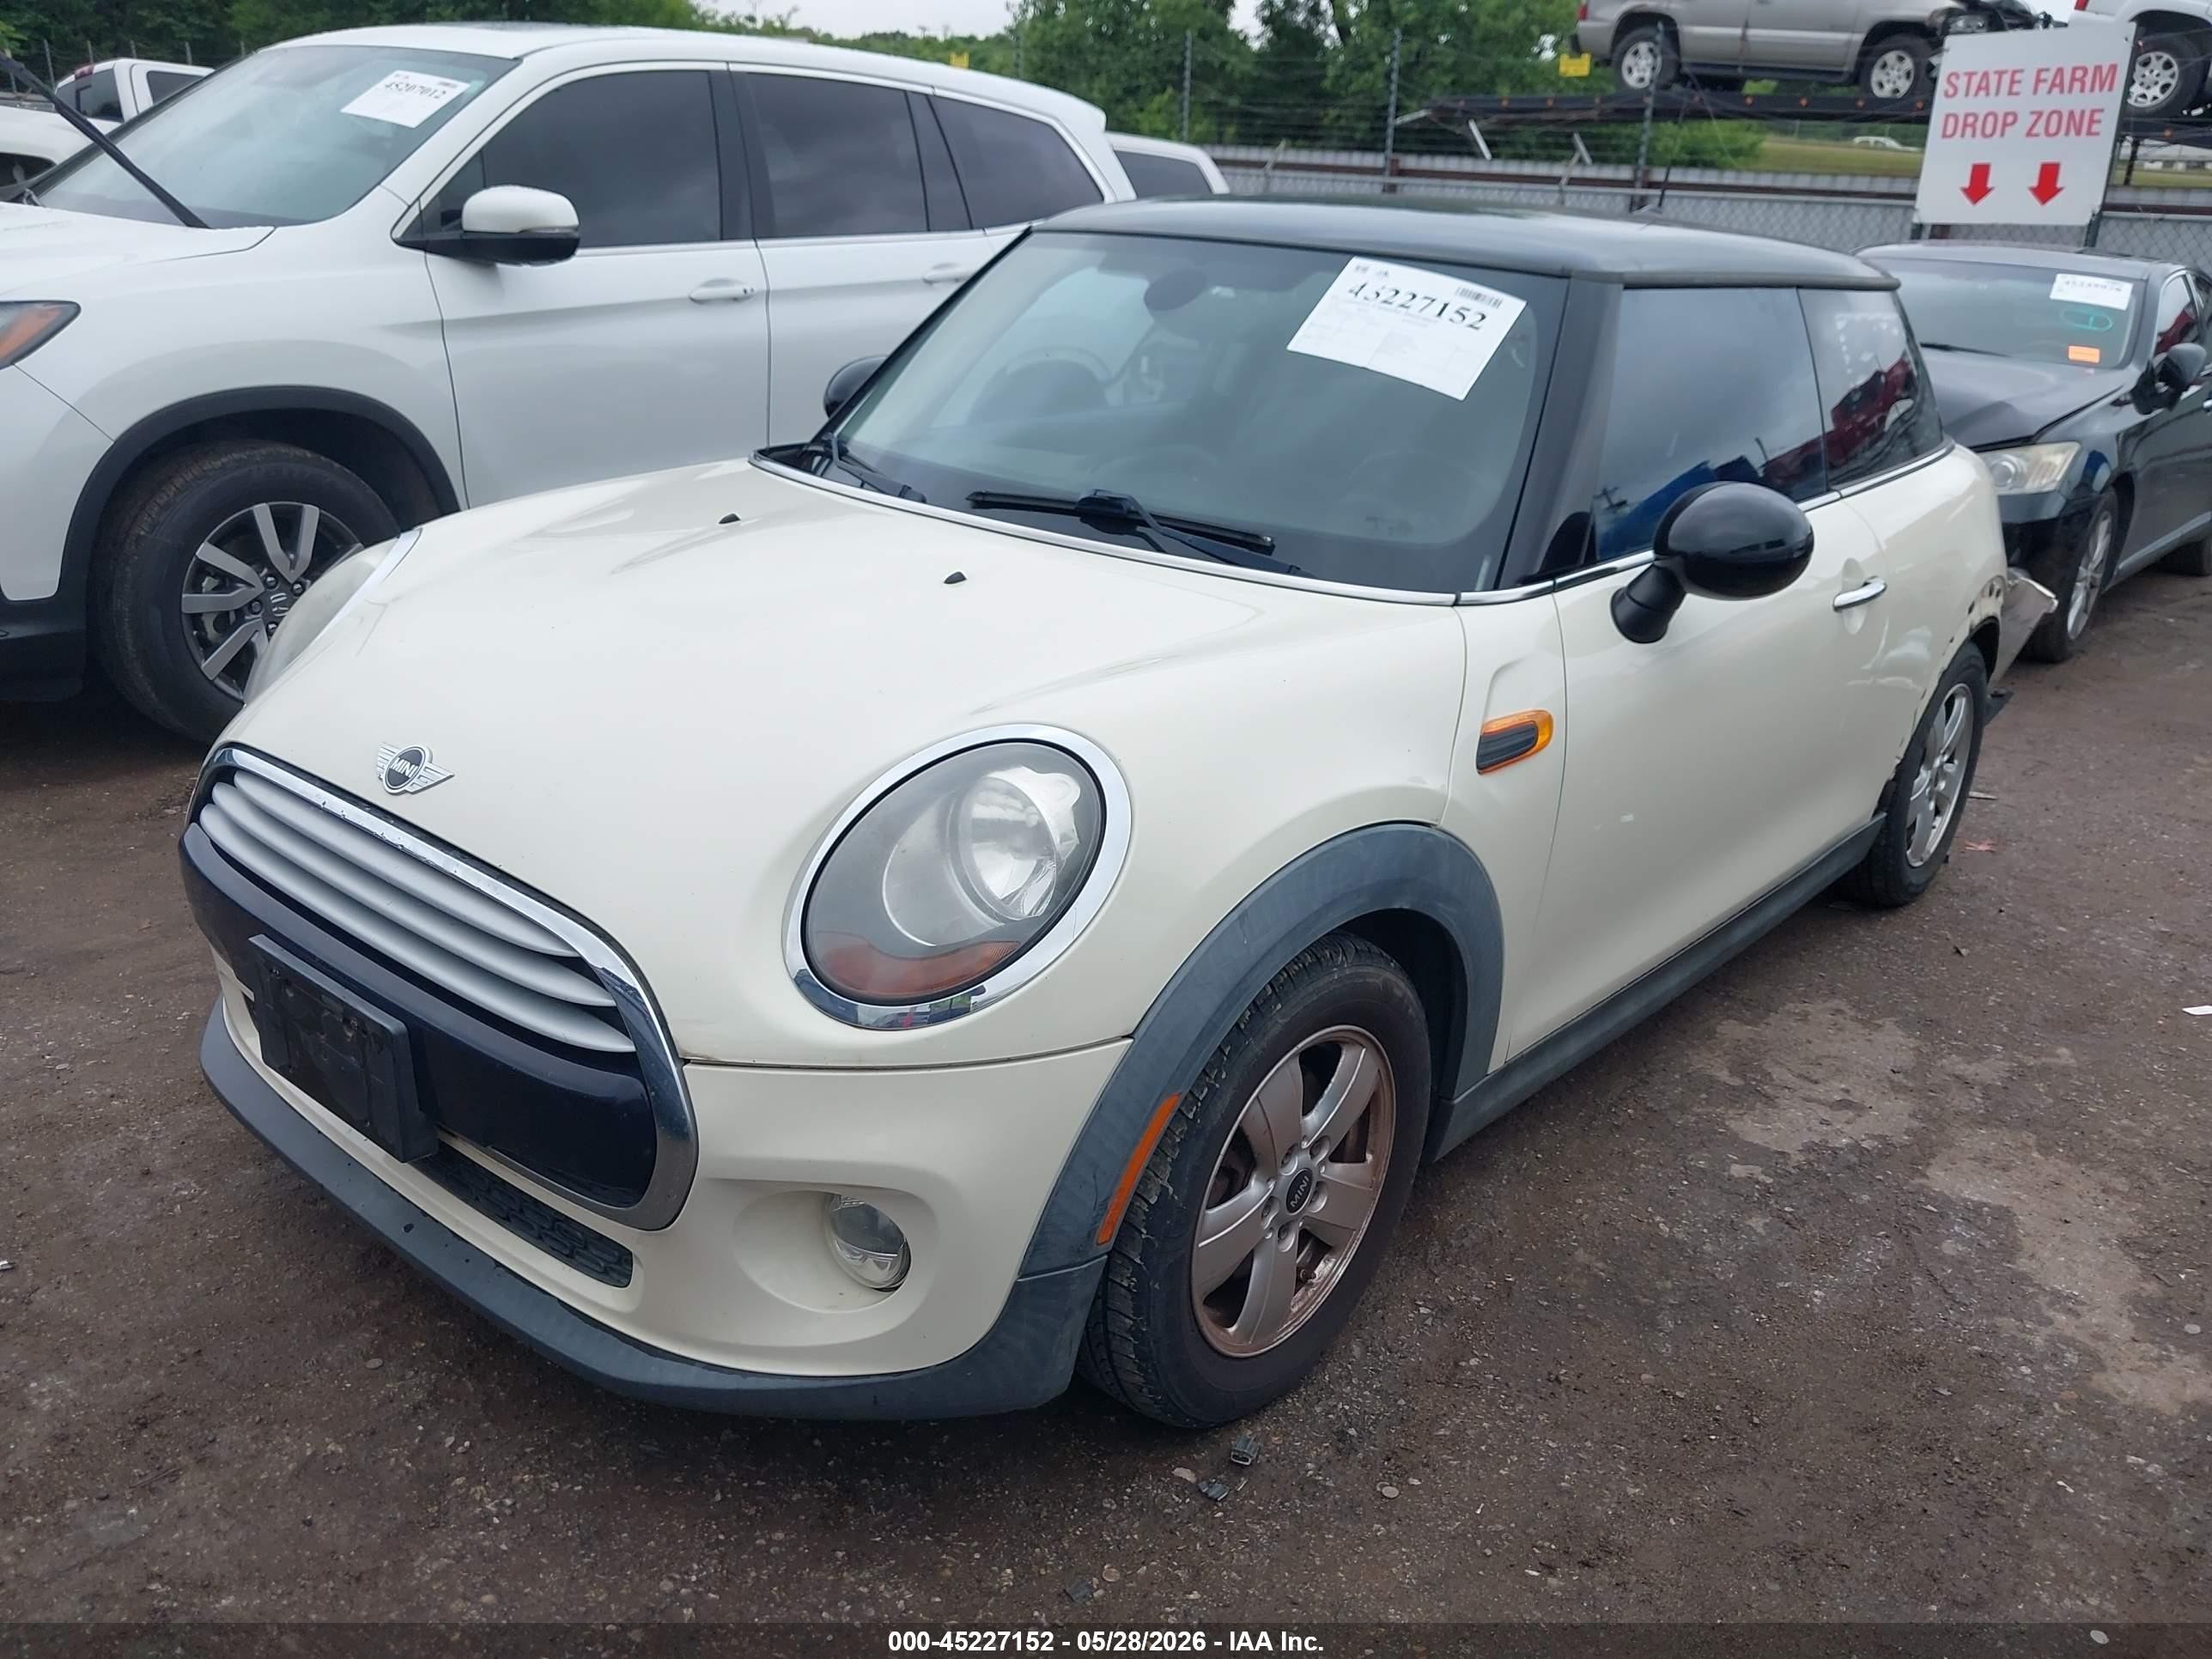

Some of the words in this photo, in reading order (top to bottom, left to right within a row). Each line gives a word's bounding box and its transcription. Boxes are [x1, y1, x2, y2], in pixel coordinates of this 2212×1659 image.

[1943, 68, 2025, 99] STATE
[2032, 63, 2118, 95] FARM
[1941, 110, 2019, 139] DROP
[2025, 108, 2105, 138] ZONE
[390, 757, 419, 778] MINI
[1290, 1175, 1310, 1207] MINI
